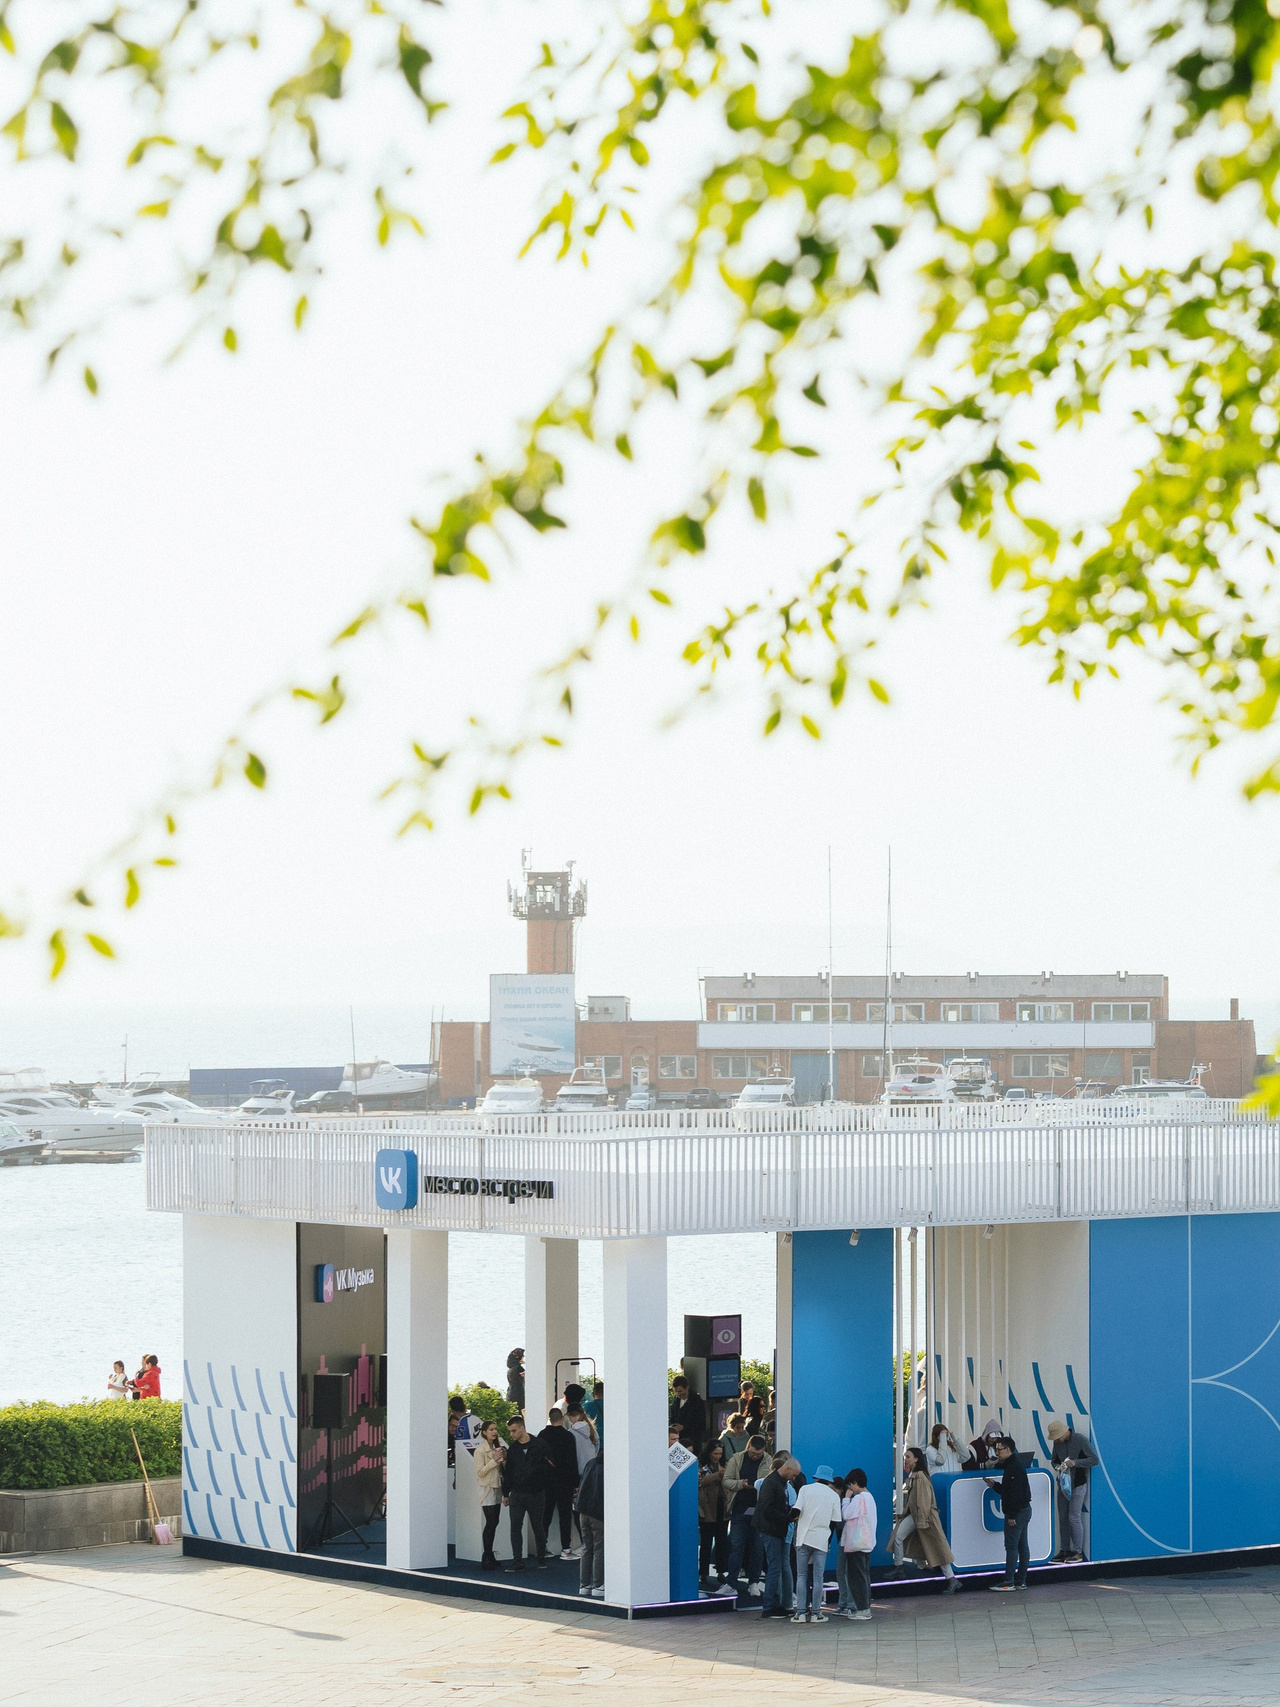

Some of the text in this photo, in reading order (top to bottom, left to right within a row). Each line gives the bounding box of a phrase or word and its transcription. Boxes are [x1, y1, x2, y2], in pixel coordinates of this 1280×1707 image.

[497, 985, 569, 995] ТИХИЙ ОКЕАН
[379, 1166, 403, 1194] VK
[424, 1175, 554, 1204] место встречи
[336, 1267, 375, 1293] VK Музыка
